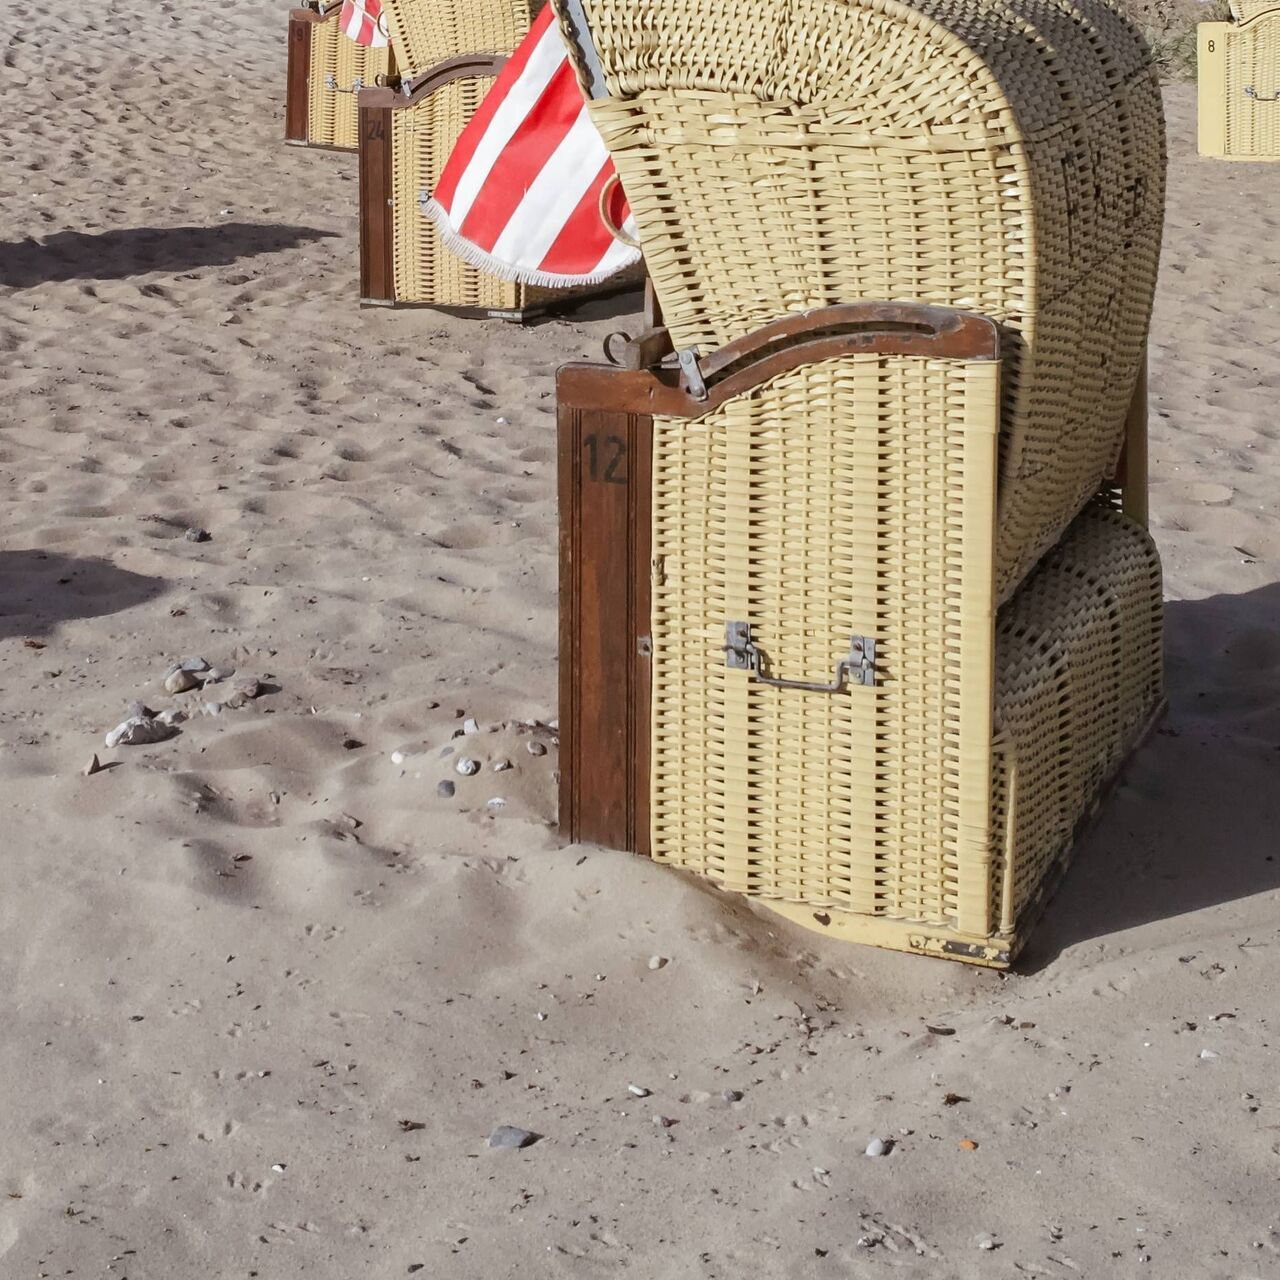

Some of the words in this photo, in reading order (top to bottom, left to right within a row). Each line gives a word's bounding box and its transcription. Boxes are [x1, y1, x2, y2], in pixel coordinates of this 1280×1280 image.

[1208, 39, 1215, 53] 8
[367, 120, 385, 140] 24
[583, 433, 628, 485] 12
